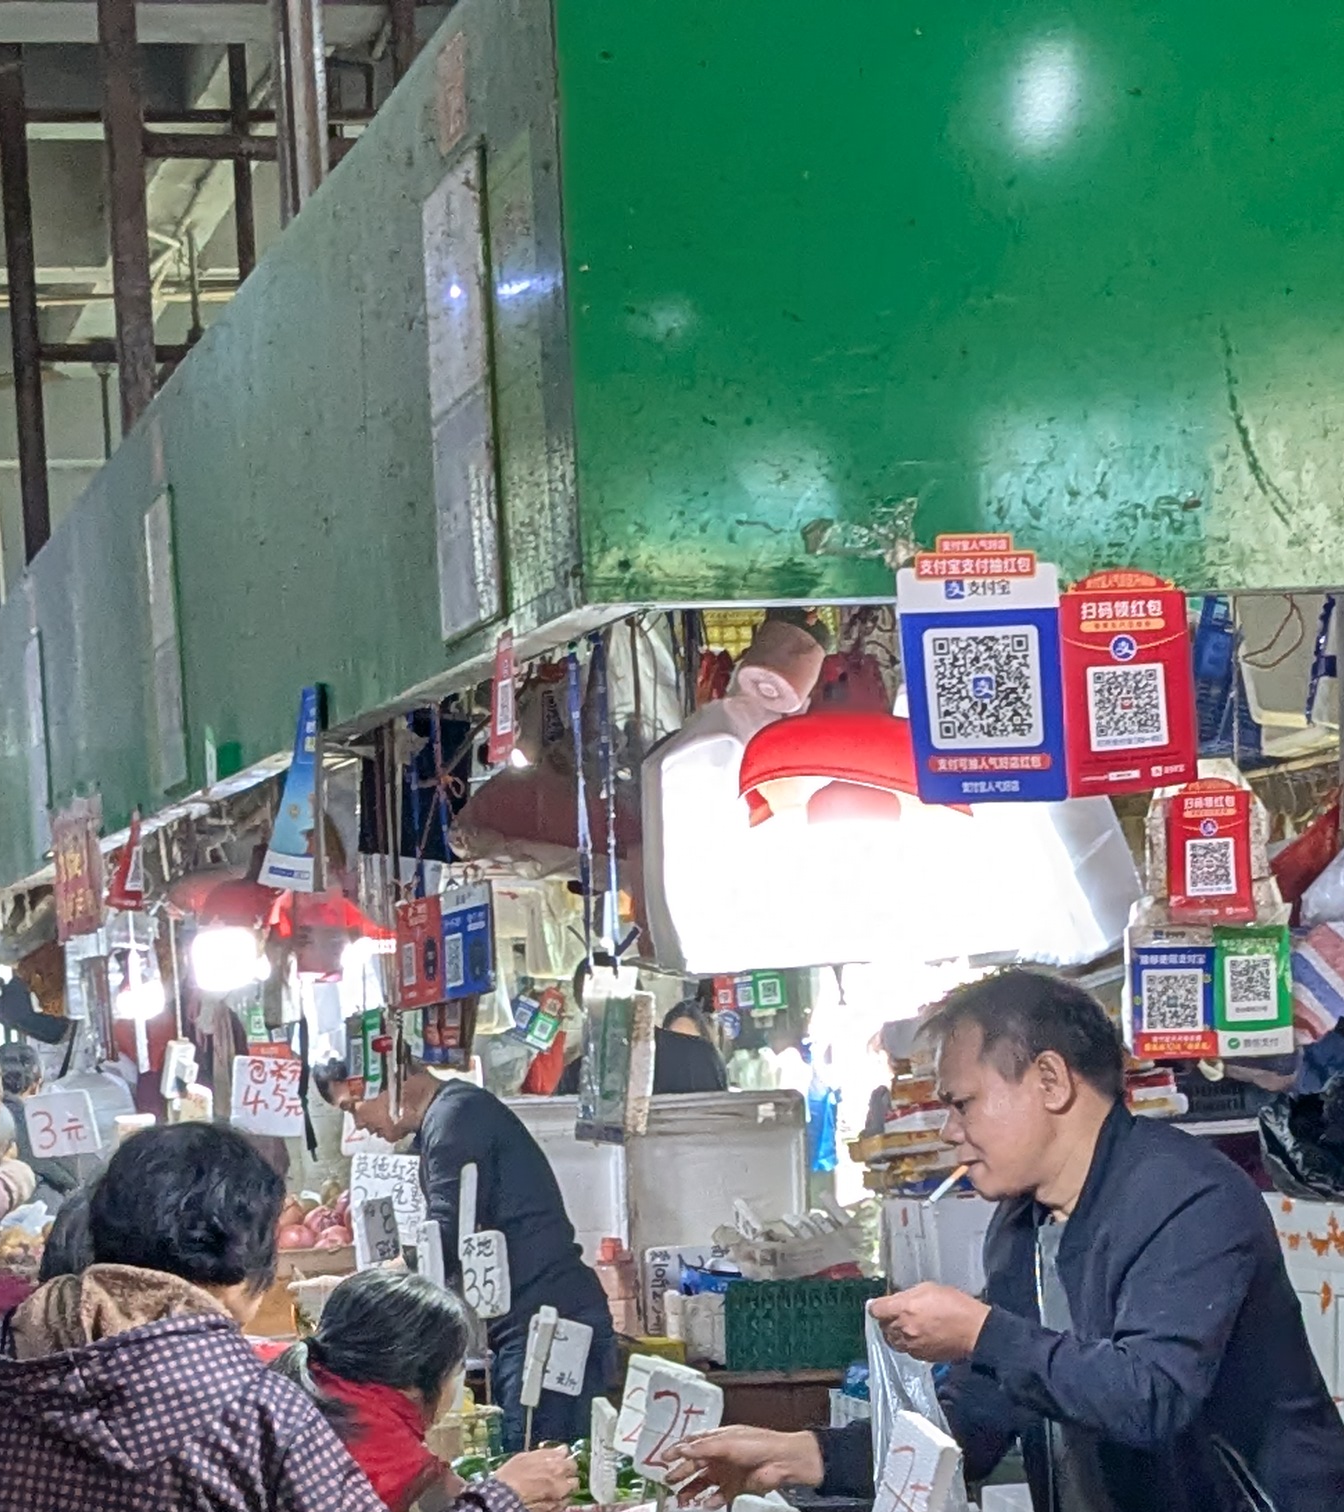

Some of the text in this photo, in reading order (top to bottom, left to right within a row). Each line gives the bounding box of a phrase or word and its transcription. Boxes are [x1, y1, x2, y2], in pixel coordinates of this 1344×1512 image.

[919, 557, 1031, 575] 支付宝支付抽红包
[967, 580, 1011, 595] 支付宝
[1080, 599, 1163, 620] 扫码领红包
